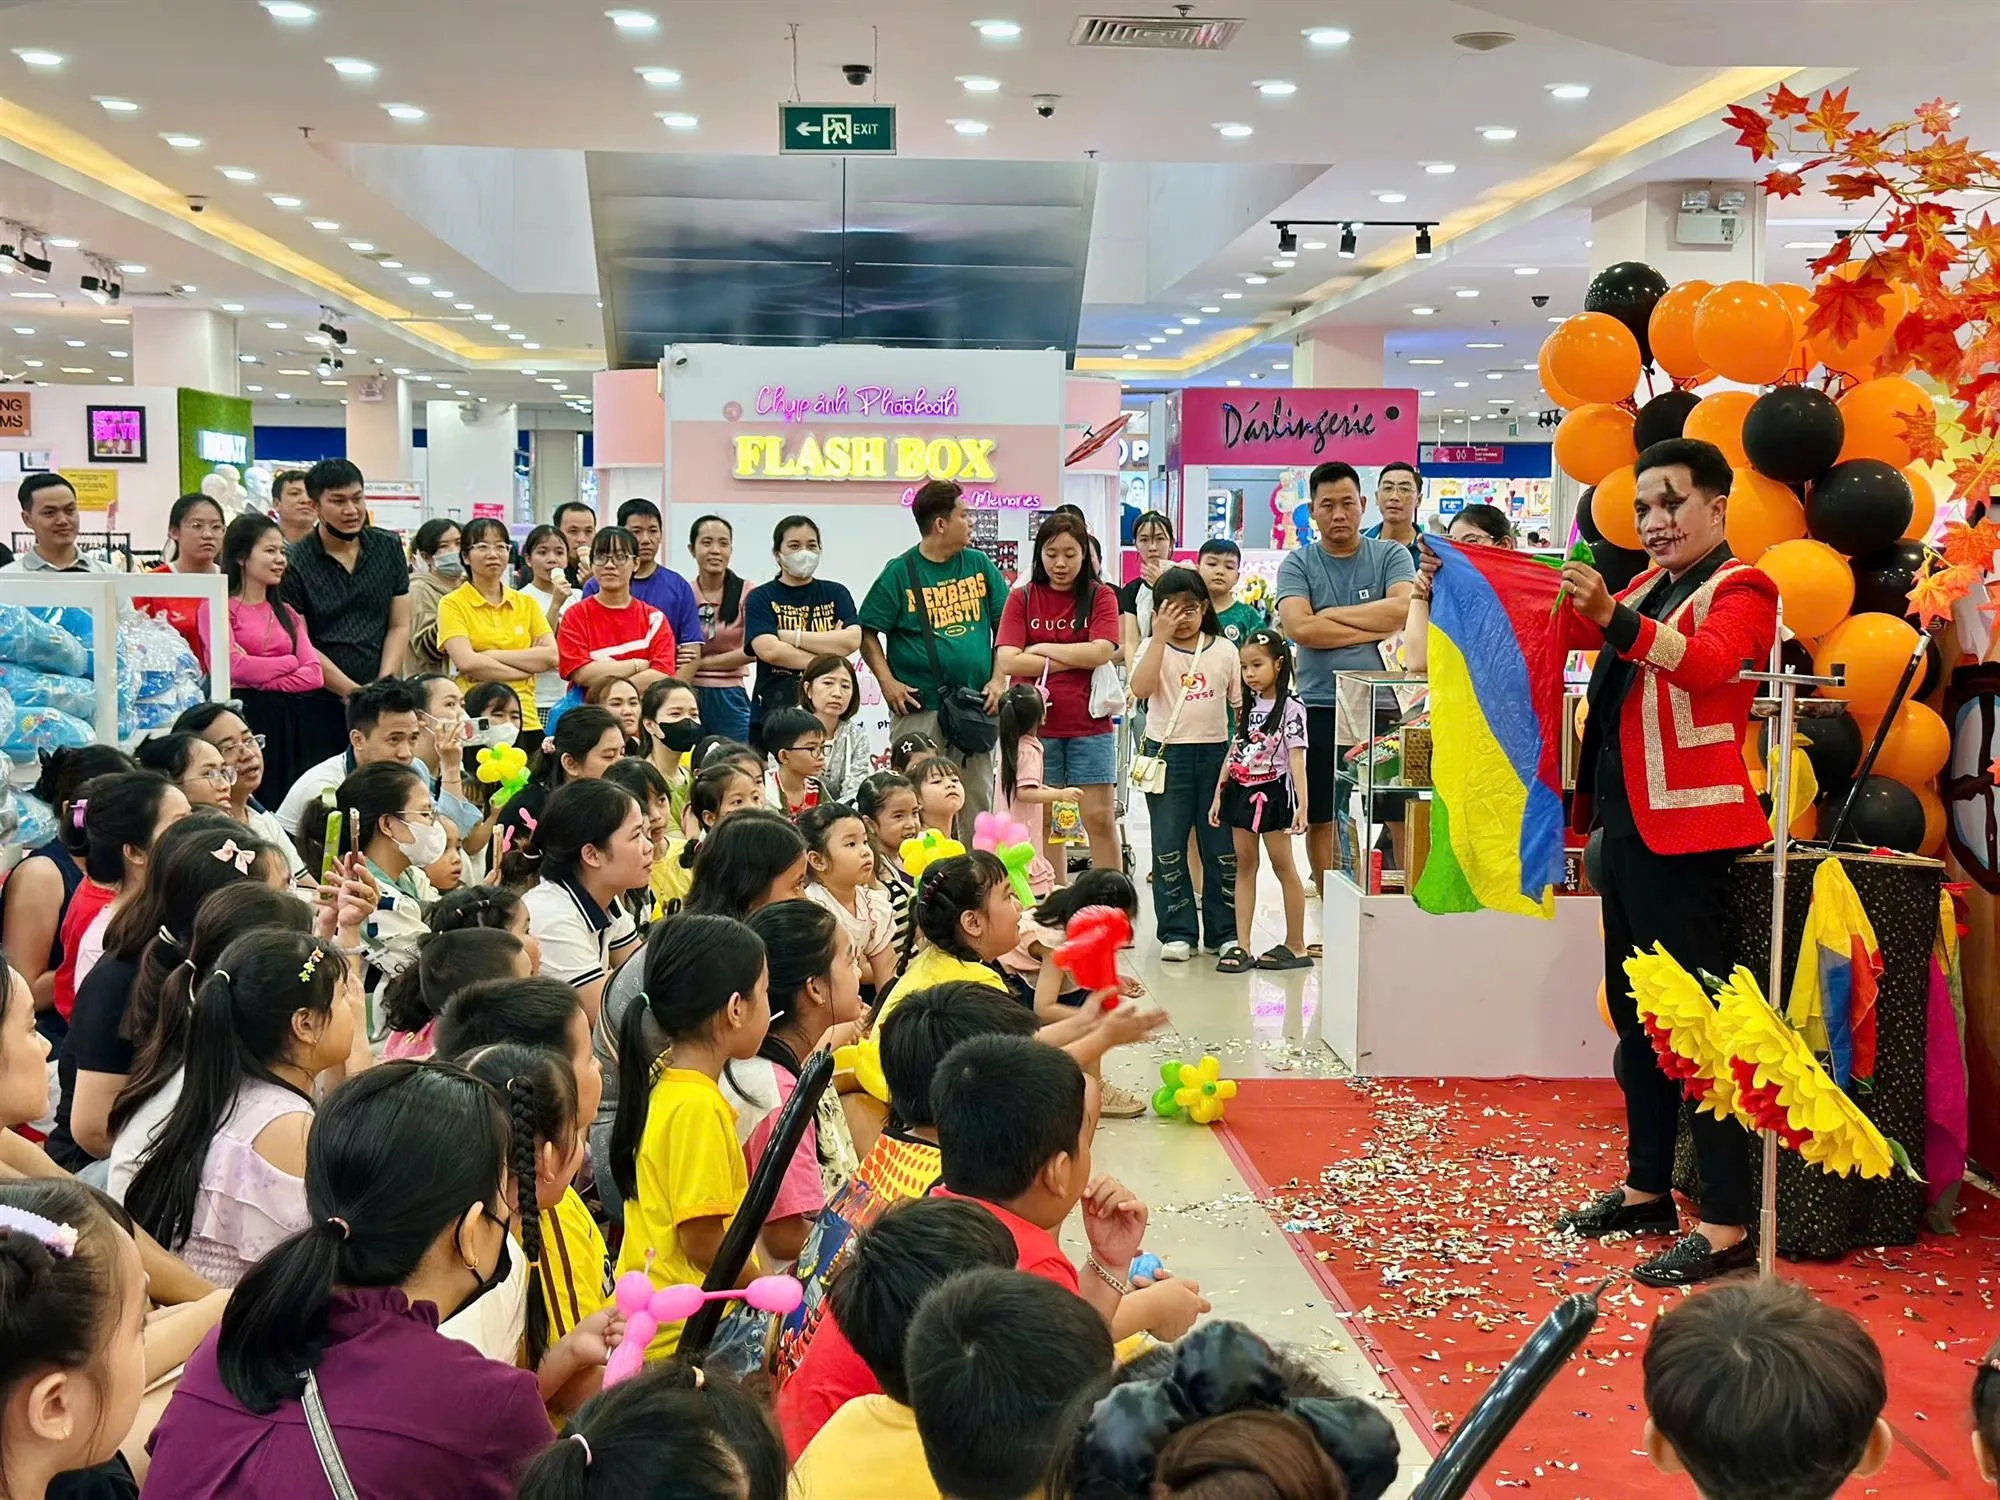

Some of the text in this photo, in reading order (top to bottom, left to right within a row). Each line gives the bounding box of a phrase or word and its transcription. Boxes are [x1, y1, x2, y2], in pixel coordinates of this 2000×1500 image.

[853, 123, 879, 135] EXIT
[813, 384, 850, 415] ảnh
[855, 385, 958, 417] Photobooth
[734, 434, 996, 479] FLASH BOX
[970, 490, 1041, 509] Memories
[1030, 617, 1089, 631] GUCCI
